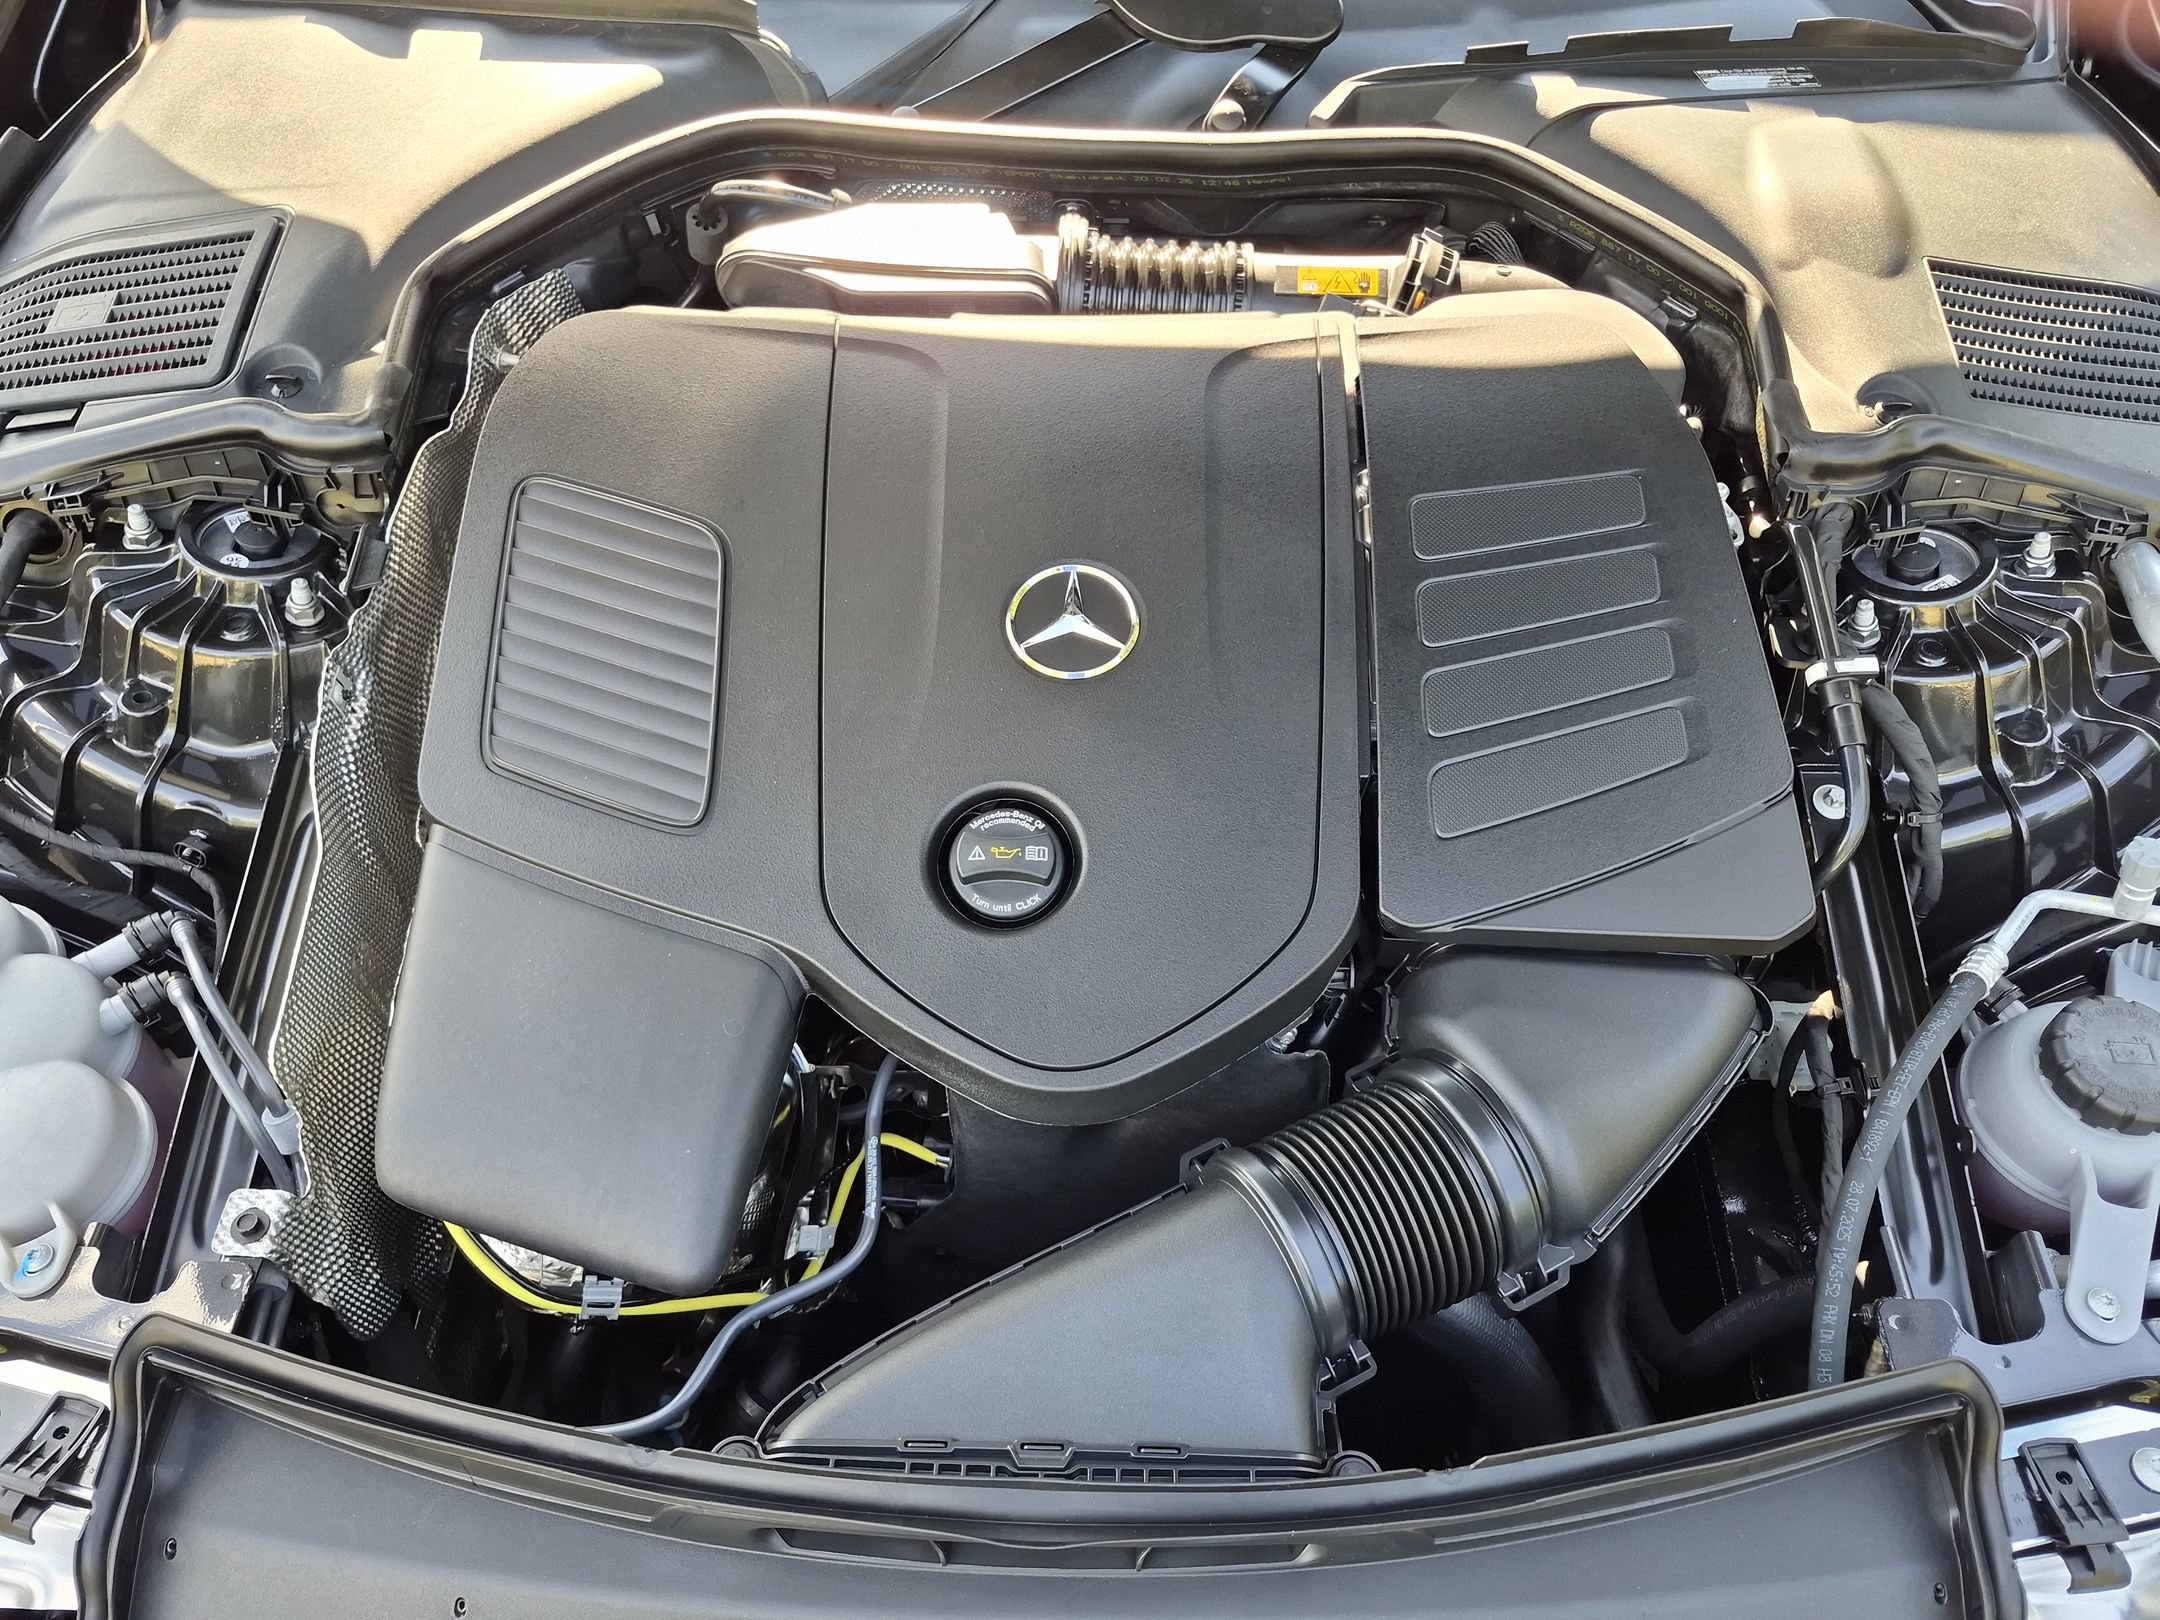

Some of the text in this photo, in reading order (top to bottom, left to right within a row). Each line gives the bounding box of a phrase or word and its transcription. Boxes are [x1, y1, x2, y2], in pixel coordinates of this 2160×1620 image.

[969, 810, 1046, 830] Mercedes-Benz Oil
[980, 817, 1037, 832] recommended
[971, 893, 1042, 912] Turn until CLICK
[1836, 1180, 1865, 1242] 28.07.2025
[1825, 1247, 1848, 1298] 19:45:52
[1822, 1304, 1838, 1325] PHX
[1820, 1329, 1835, 1344] DN
